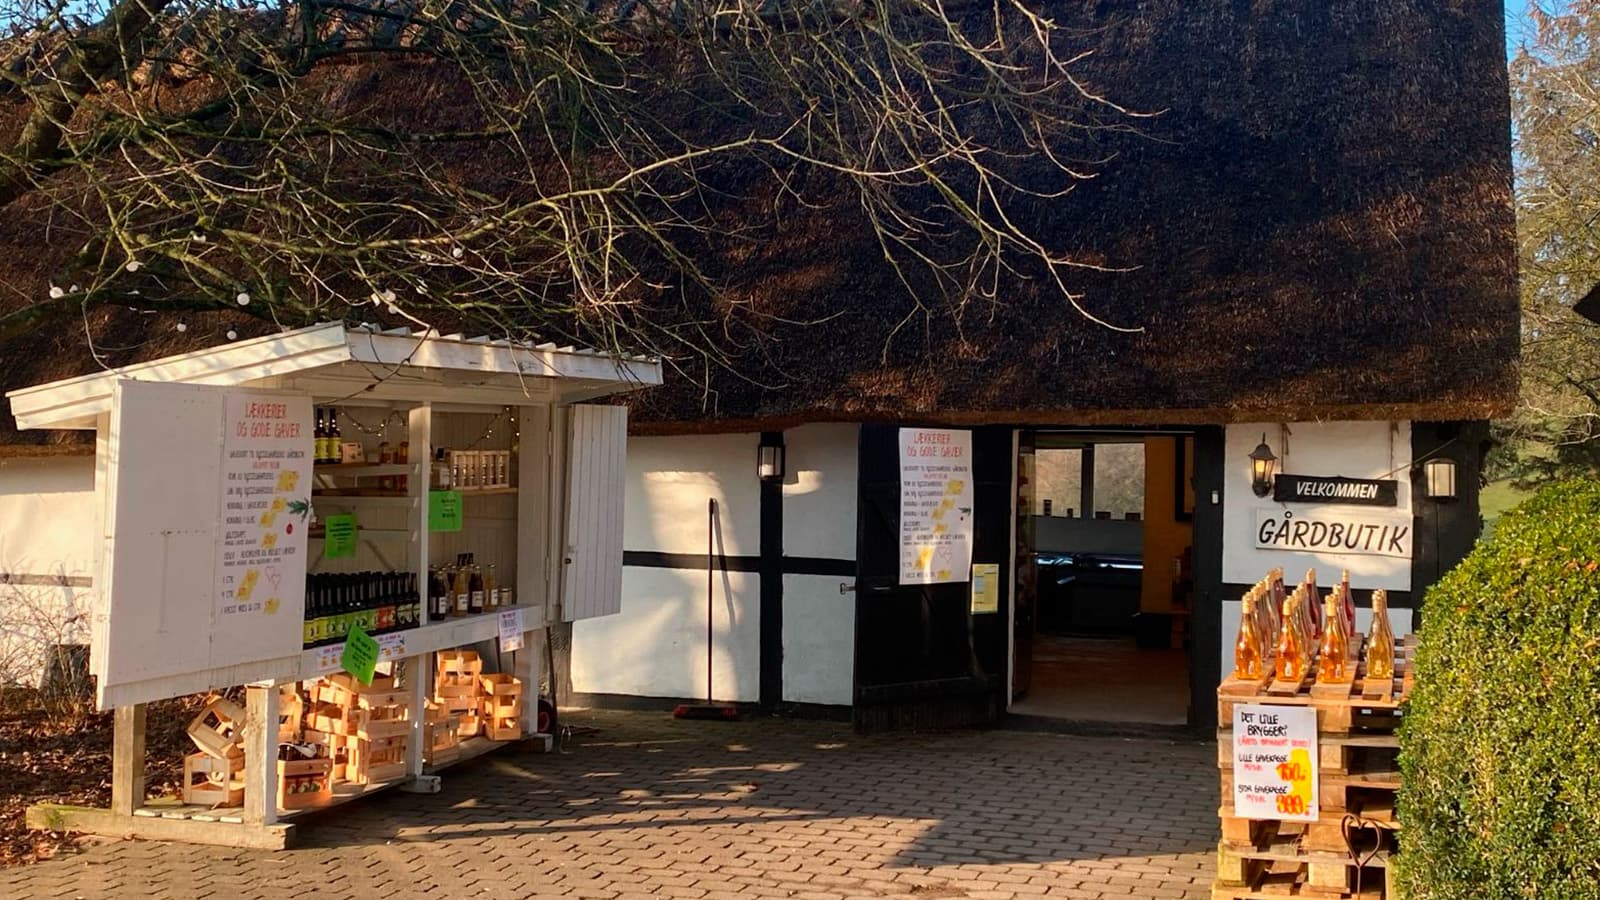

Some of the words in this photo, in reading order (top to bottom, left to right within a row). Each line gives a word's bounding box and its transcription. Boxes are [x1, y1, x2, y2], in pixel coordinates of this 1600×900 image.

[236, 421, 247, 437] OG
[251, 421, 272, 438] GODE
[274, 422, 301, 439] GAVER
[1295, 481, 1379, 499] VELKOMMEN
[1259, 511, 1409, 553] GÅRDBUTIK
[1241, 711, 1255, 723] DET
[1259, 713, 1279, 725] LILLE
[1238, 753, 1253, 762] LILLE
